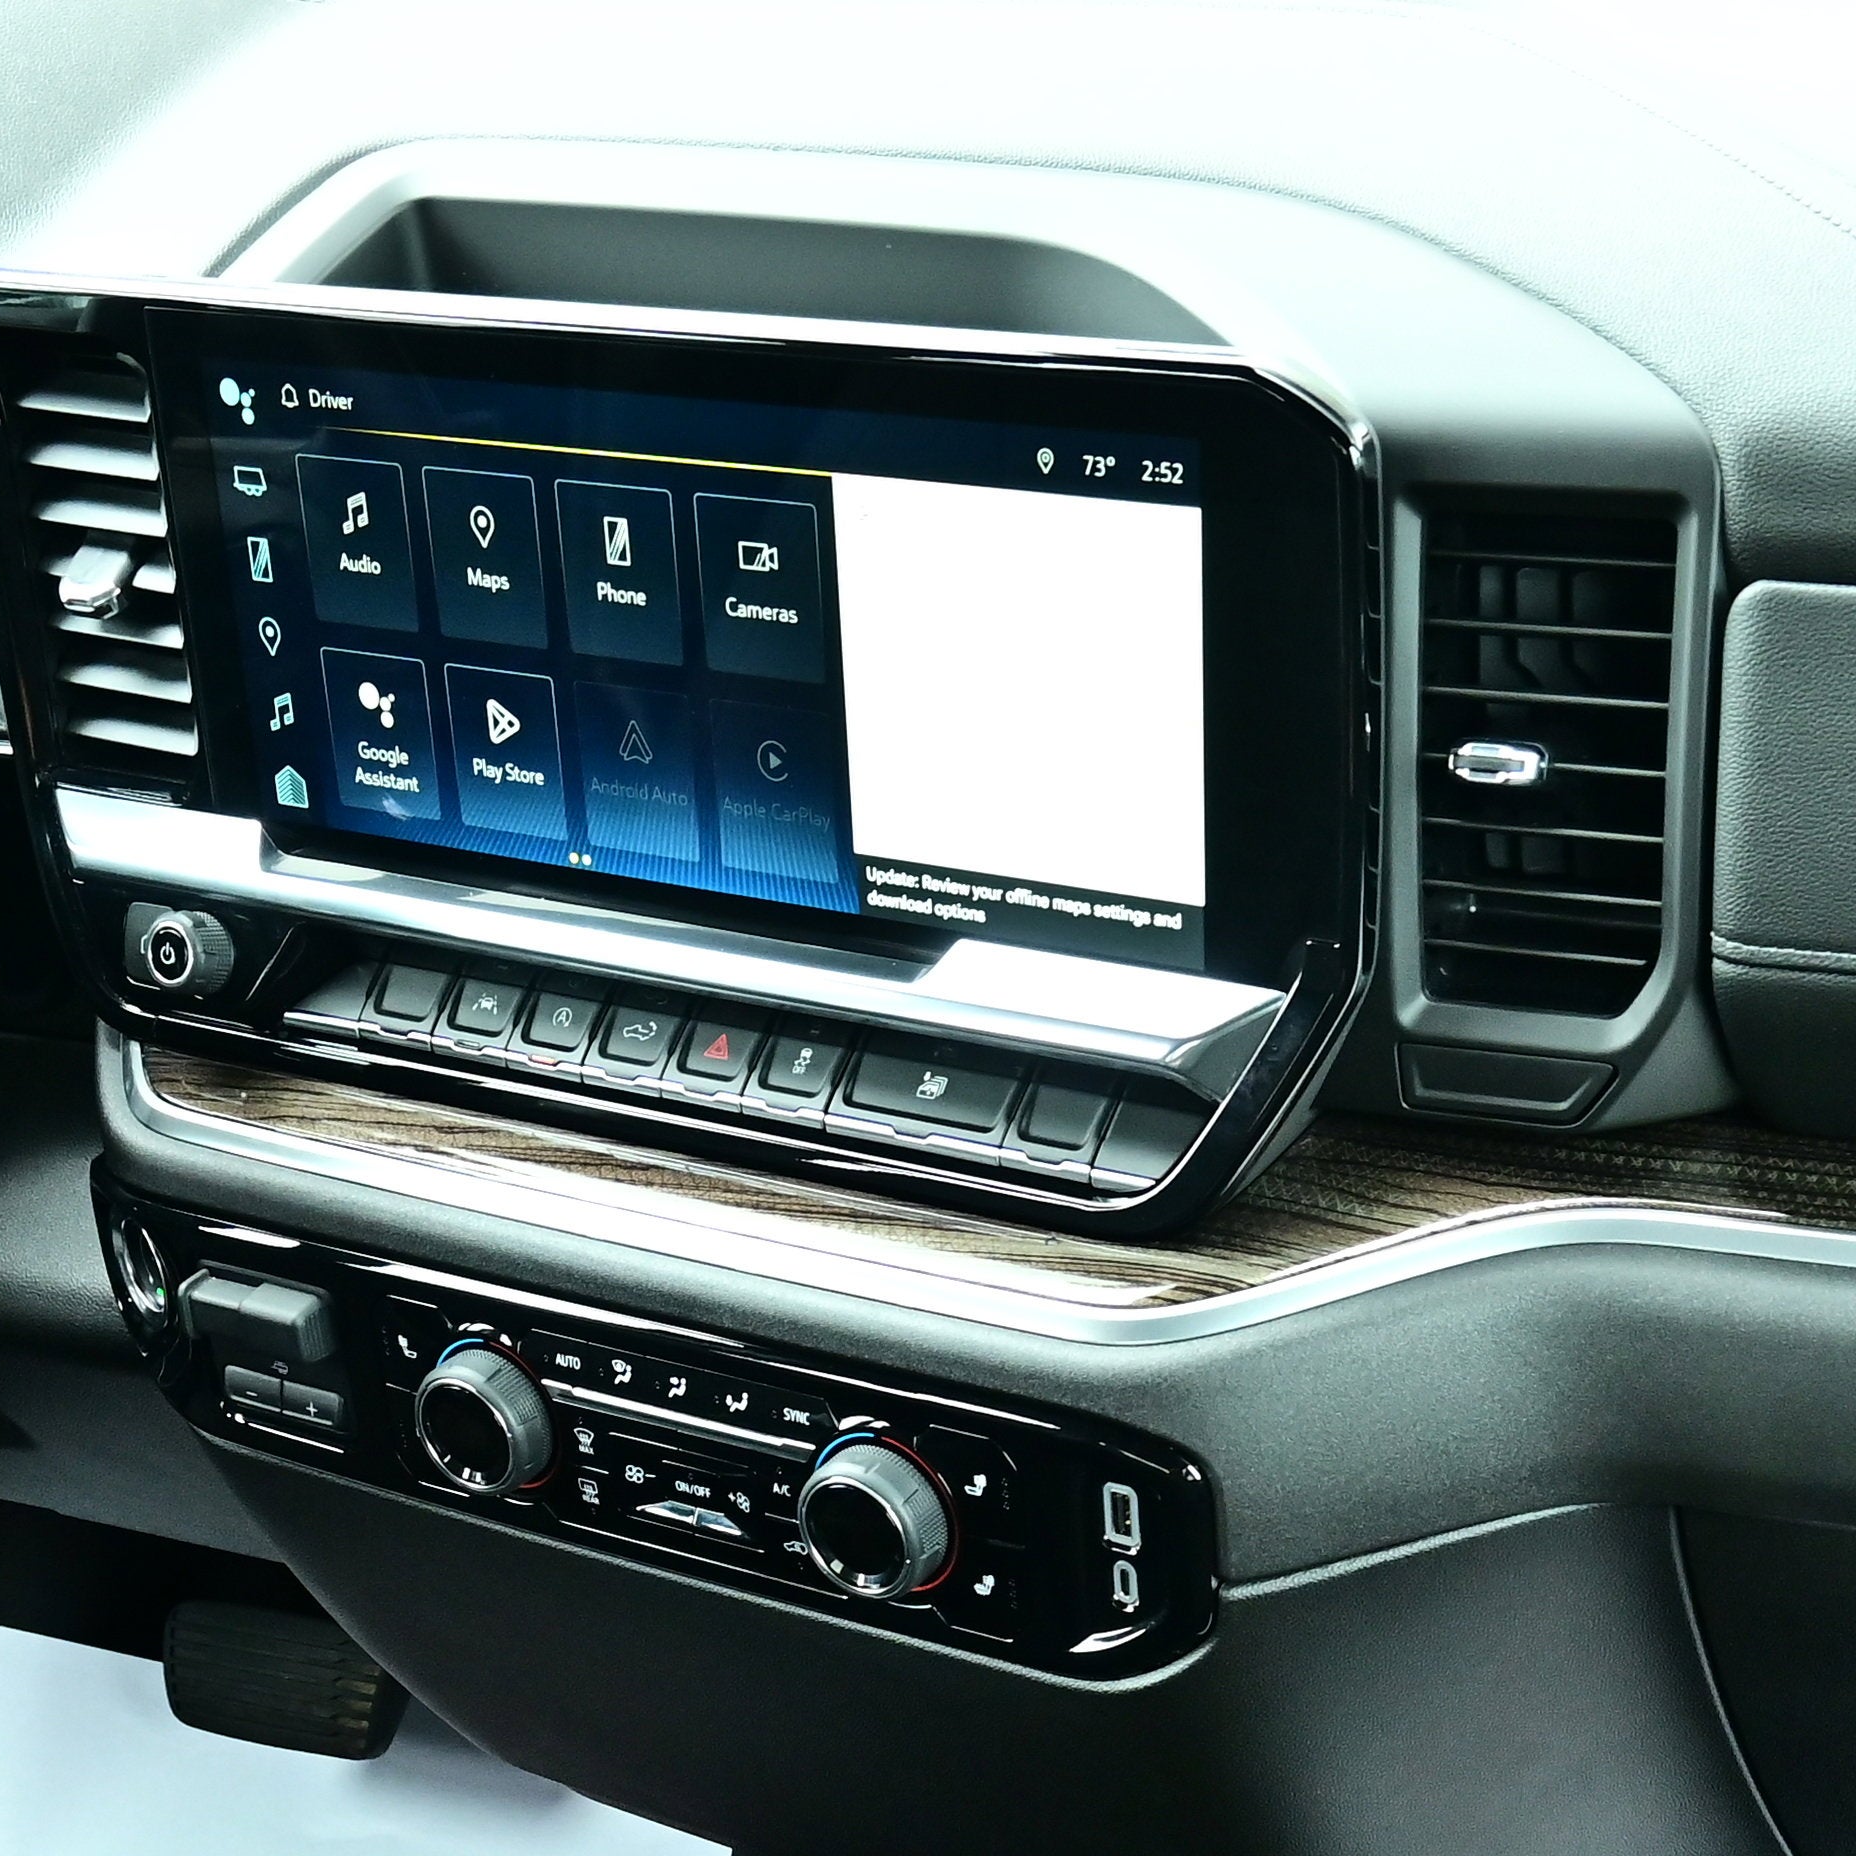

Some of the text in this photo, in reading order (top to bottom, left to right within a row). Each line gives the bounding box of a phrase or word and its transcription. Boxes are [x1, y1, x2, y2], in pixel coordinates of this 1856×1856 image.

[308, 388, 354, 411] Driver
[1141, 460, 1184, 485] 2:52
[340, 552, 381, 575] Audio
[466, 566, 510, 593] Maps
[597, 581, 647, 606] Phone
[725, 597, 799, 624] Cameras
[357, 741, 409, 768] Google
[355, 767, 420, 793] Assistant
[472, 757, 545, 786] Play Store
[590, 776, 689, 806] Android Auto
[723, 796, 831, 830] Apple CarPlay
[865, 865, 1183, 930] Update: Review your offline maps settings and
[866, 889, 986, 924] download options
[555, 1352, 581, 1371] AUTO
[783, 1407, 811, 1426] SYNC
[674, 1480, 711, 1499] ON/OFF
[772, 1482, 792, 1497] A/C
